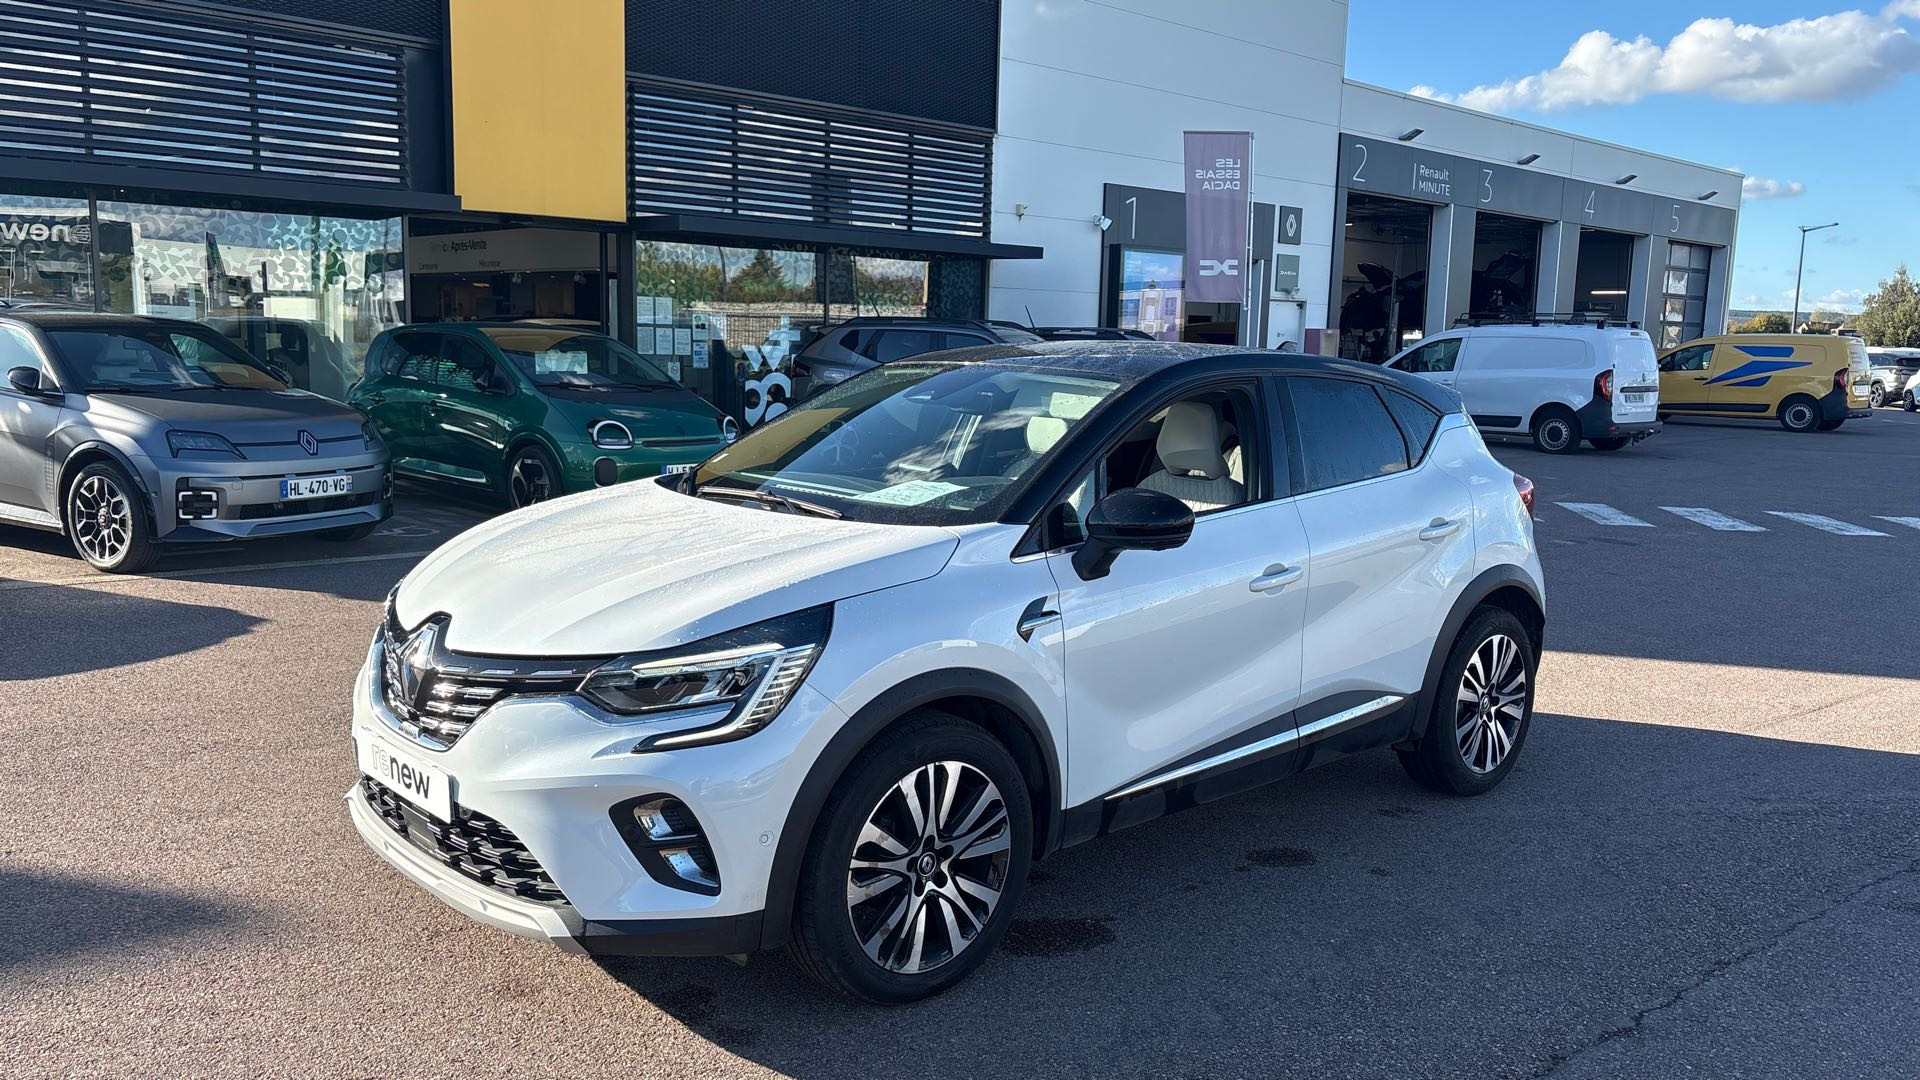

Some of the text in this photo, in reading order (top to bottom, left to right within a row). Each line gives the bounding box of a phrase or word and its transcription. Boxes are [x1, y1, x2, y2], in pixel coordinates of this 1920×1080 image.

[1353, 144, 1367, 182] 2
[1420, 164, 1449, 180] Renault
[1418, 181, 1451, 196] MINUTE
[1480, 169, 1493, 203] 3
[1125, 196, 1137, 239] 1
[1584, 190, 1596, 219] 4
[1670, 204, 1681, 233] 5
[289, 478, 345, 496] HL-470-VG
[371, 743, 430, 799] renew
